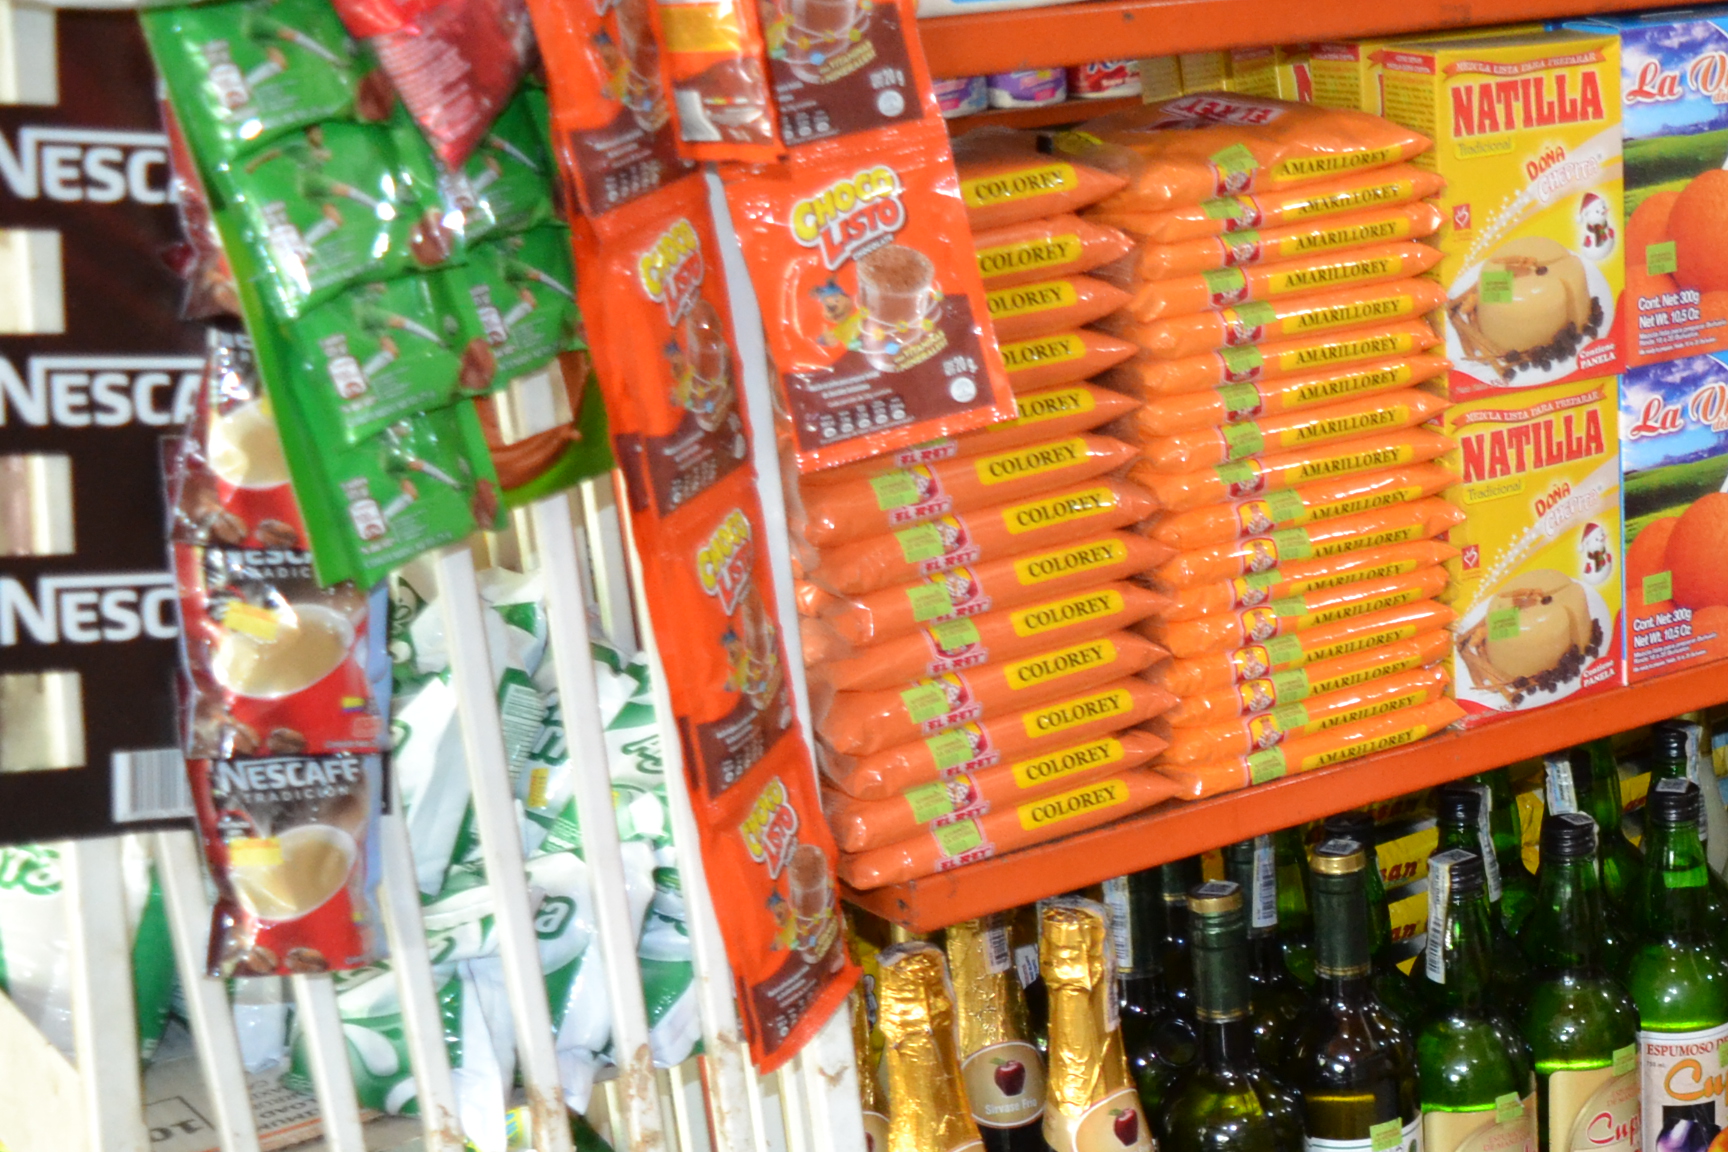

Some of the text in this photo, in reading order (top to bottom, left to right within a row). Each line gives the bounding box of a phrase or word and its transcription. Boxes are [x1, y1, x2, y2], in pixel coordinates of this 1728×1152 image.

[1493, 59, 1519, 72] LISTA
[1521, 57, 1545, 70] PARA
[1547, 52, 1597, 68] PREPARAR
[1626, 61, 1681, 103] La
[1451, 71, 1604, 137] NATILLA
[1281, 149, 1389, 176] AMARILLOREY
[1458, 138, 1512, 157] Tradicional
[1526, 145, 1566, 182] DOÑA
[0, 128, 185, 202] NESC
[975, 168, 1065, 201] COLOREY
[790, 166, 899, 245] CHOCO
[818, 197, 905, 268] LISTO
[1285, 260, 1389, 288] AMARILLOREY
[987, 287, 1065, 314] OLOREY
[1298, 300, 1400, 328] AMARILLOREY
[1579, 342, 1615, 360] Contiene
[1579, 352, 1616, 370] PANELA
[1296, 411, 1395, 440] AMARILLOREY
[1630, 398, 1684, 438] La
[989, 445, 1077, 477] COLOREY
[1461, 409, 1604, 484] NATILLA
[1300, 449, 1400, 478] AMARILLOREY
[1466, 480, 1522, 502] Tradicional
[1534, 482, 1571, 517] DOÑA
[895, 501, 948, 522] EL REY
[1312, 528, 1411, 559] AMARILLOREY
[1028, 545, 1113, 577] COLOREY
[1025, 596, 1111, 629] COLOREY
[1018, 646, 1103, 682] COLOREY
[1316, 730, 1413, 766] AMARILLOREY
[1032, 786, 1117, 822] COLOREY
[940, 848, 993, 872] EL REY
[1647, 1039, 1714, 1057] ESPUMOSO
